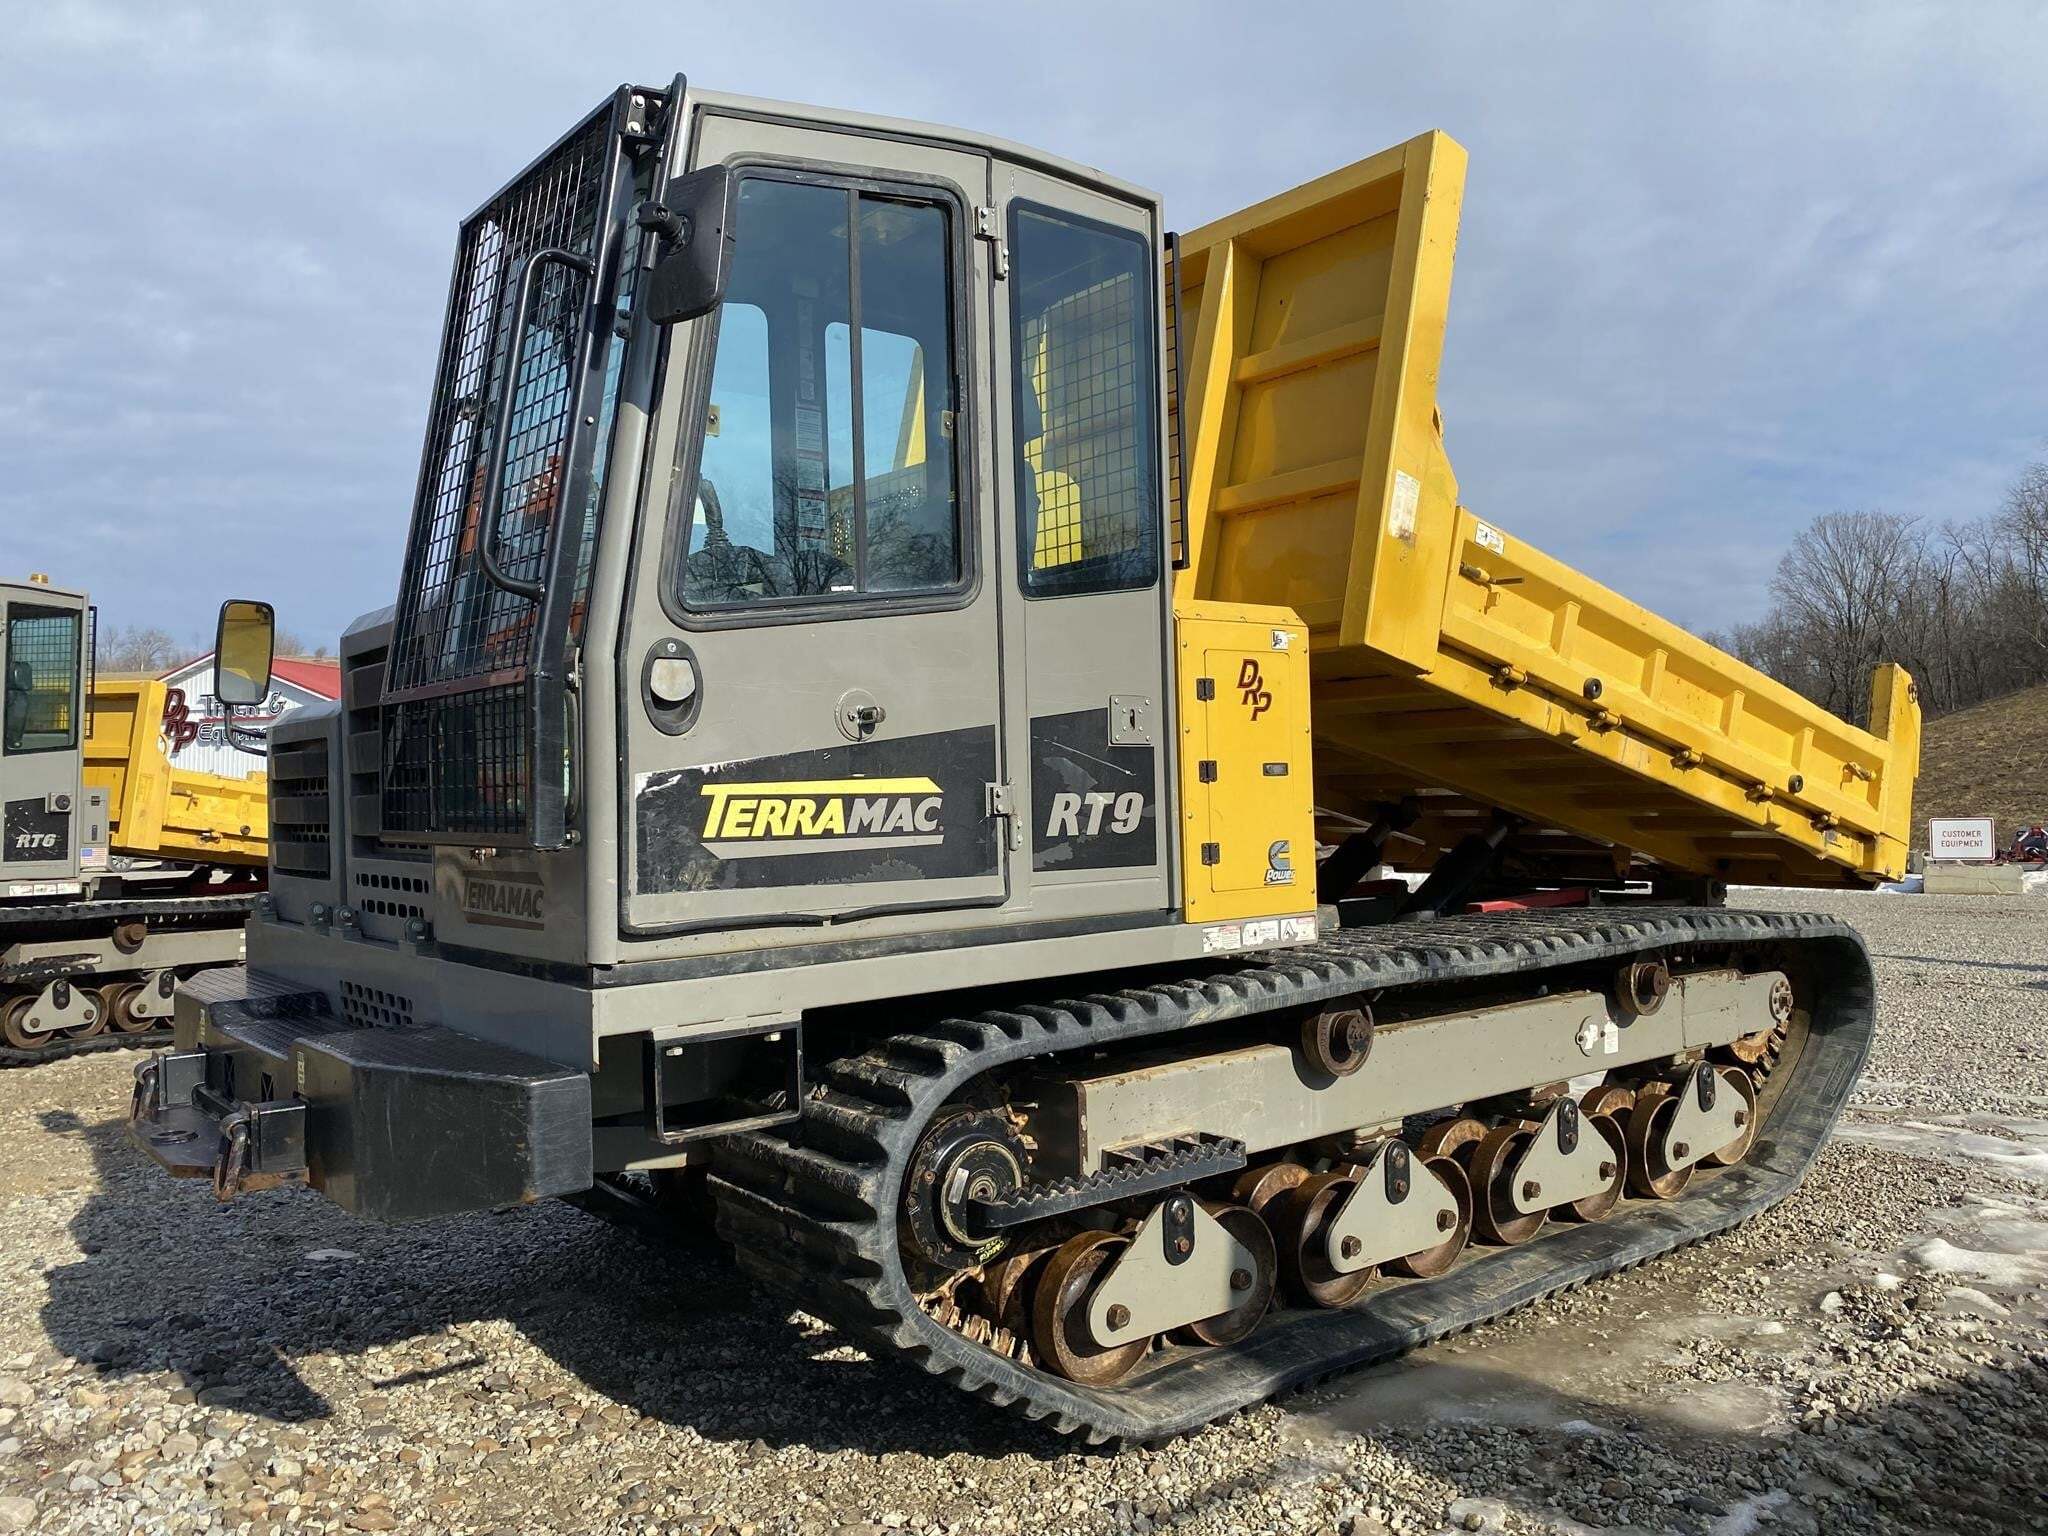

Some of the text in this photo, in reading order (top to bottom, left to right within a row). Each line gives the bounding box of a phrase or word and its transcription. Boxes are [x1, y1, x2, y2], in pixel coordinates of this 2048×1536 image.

[268, 690, 287, 715] &
[1236, 658, 1273, 722] DRP
[163, 688, 199, 753] DRP
[701, 777, 945, 839] TERRAMAC
[1045, 791, 1145, 838] RT9
[15, 833, 57, 848] RT6
[1940, 840, 1983, 848] EQUIPMENT
[1942, 830, 1982, 838] CUSTOMER
[1266, 869, 1296, 882] Power
[463, 871, 545, 920] TERRAMAC
